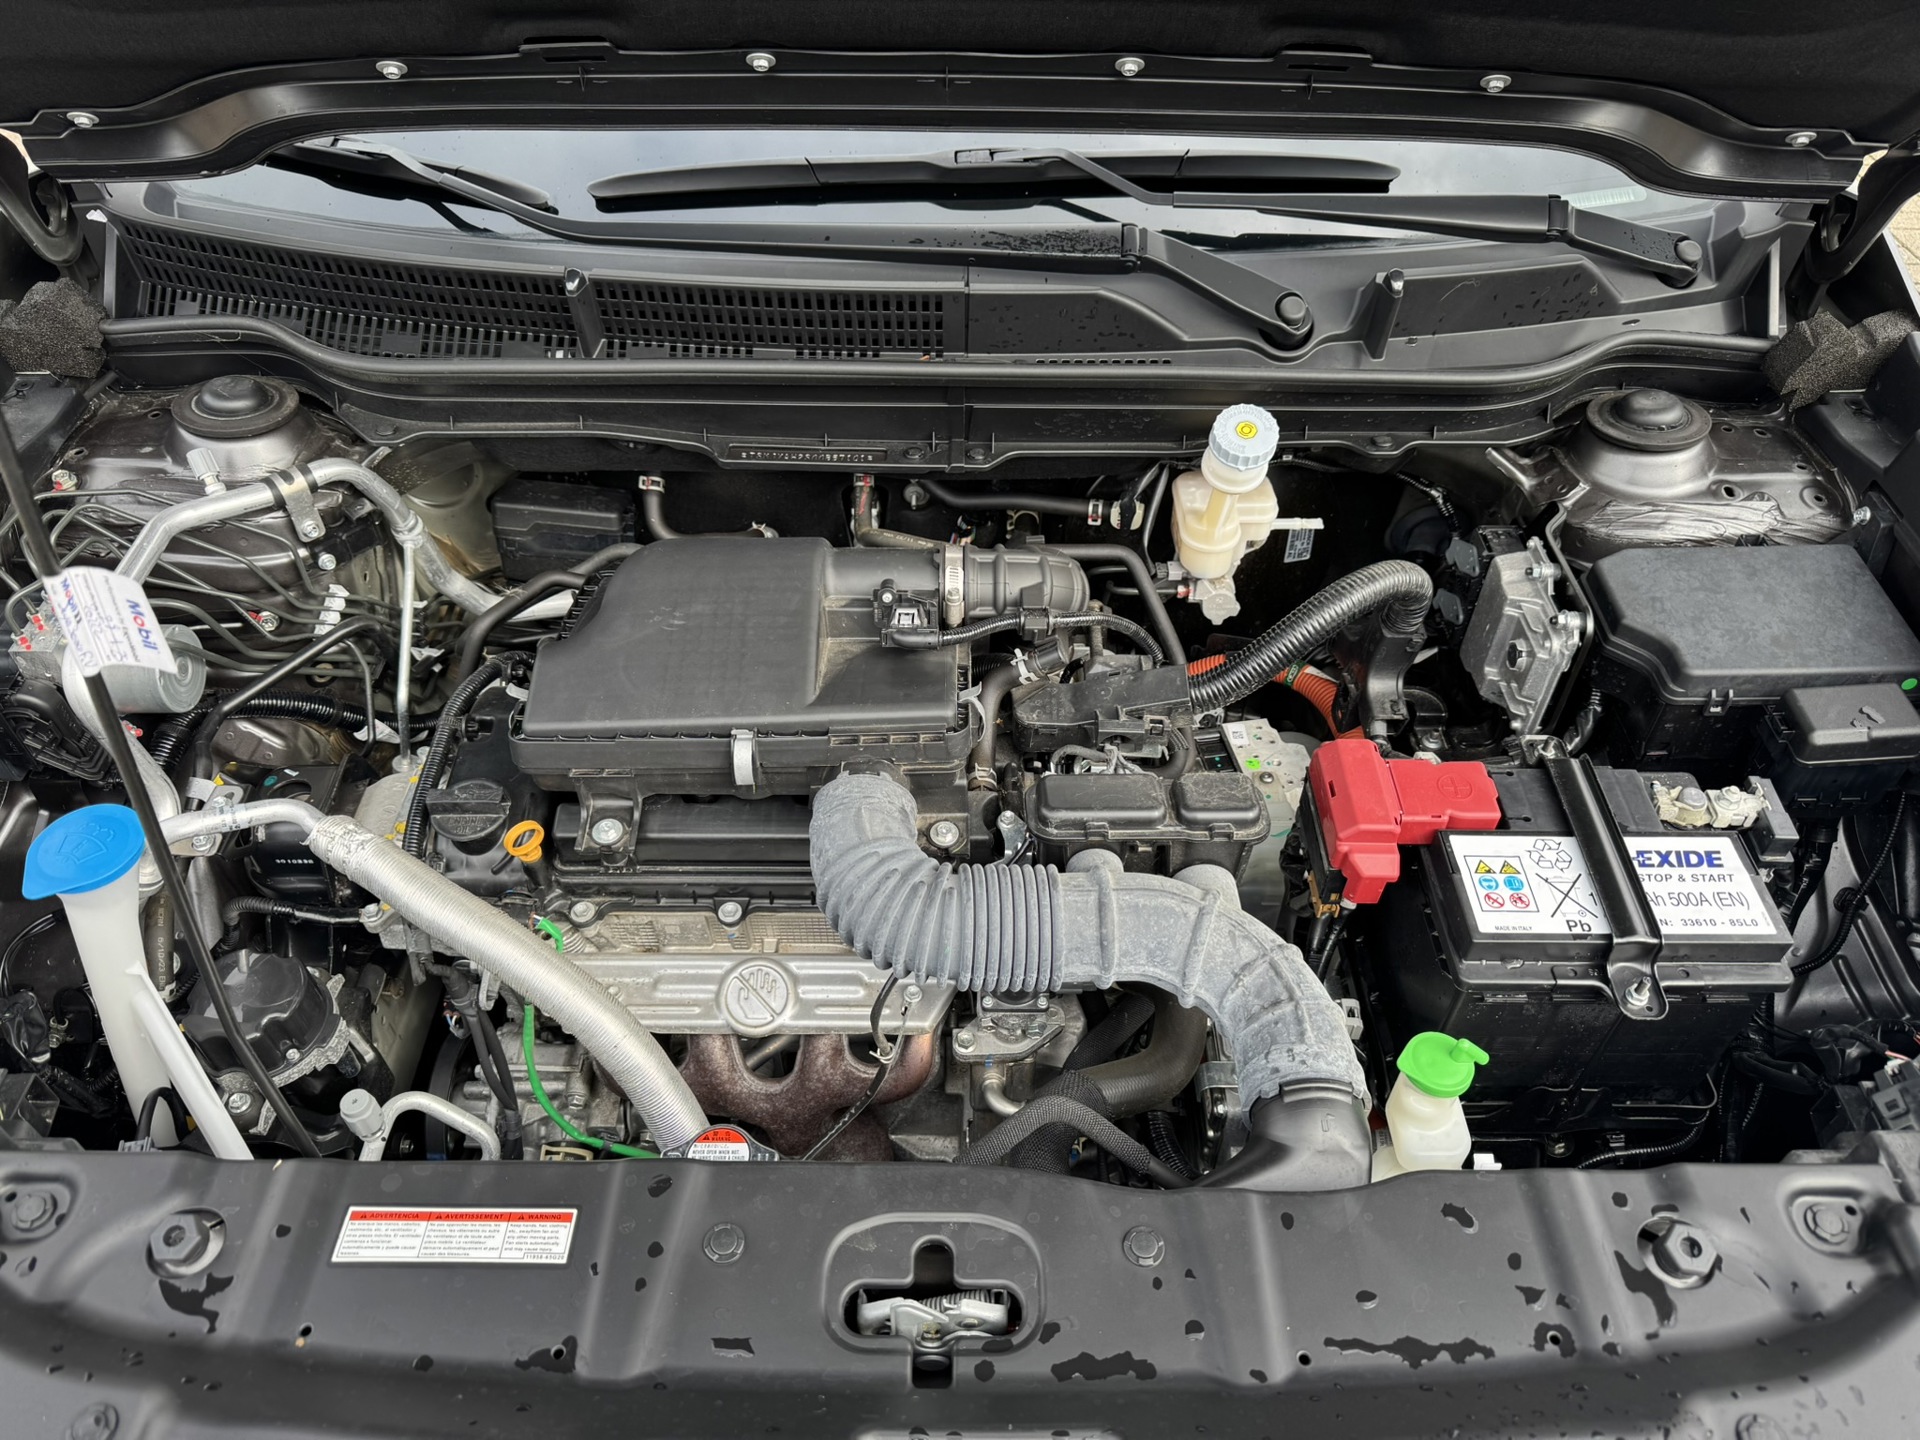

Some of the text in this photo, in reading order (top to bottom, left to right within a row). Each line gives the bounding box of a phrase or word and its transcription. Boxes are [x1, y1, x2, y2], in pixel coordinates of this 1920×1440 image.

[60, 578, 78, 612] Mobil
[126, 599, 158, 650] Mobil
[1632, 850, 1724, 868] EXIDE
[1639, 874, 1734, 882] STOP & START
[1668, 892, 1712, 907] 500A
[1712, 892, 1750, 910] (EN)
[1566, 919, 1592, 932] Pb
